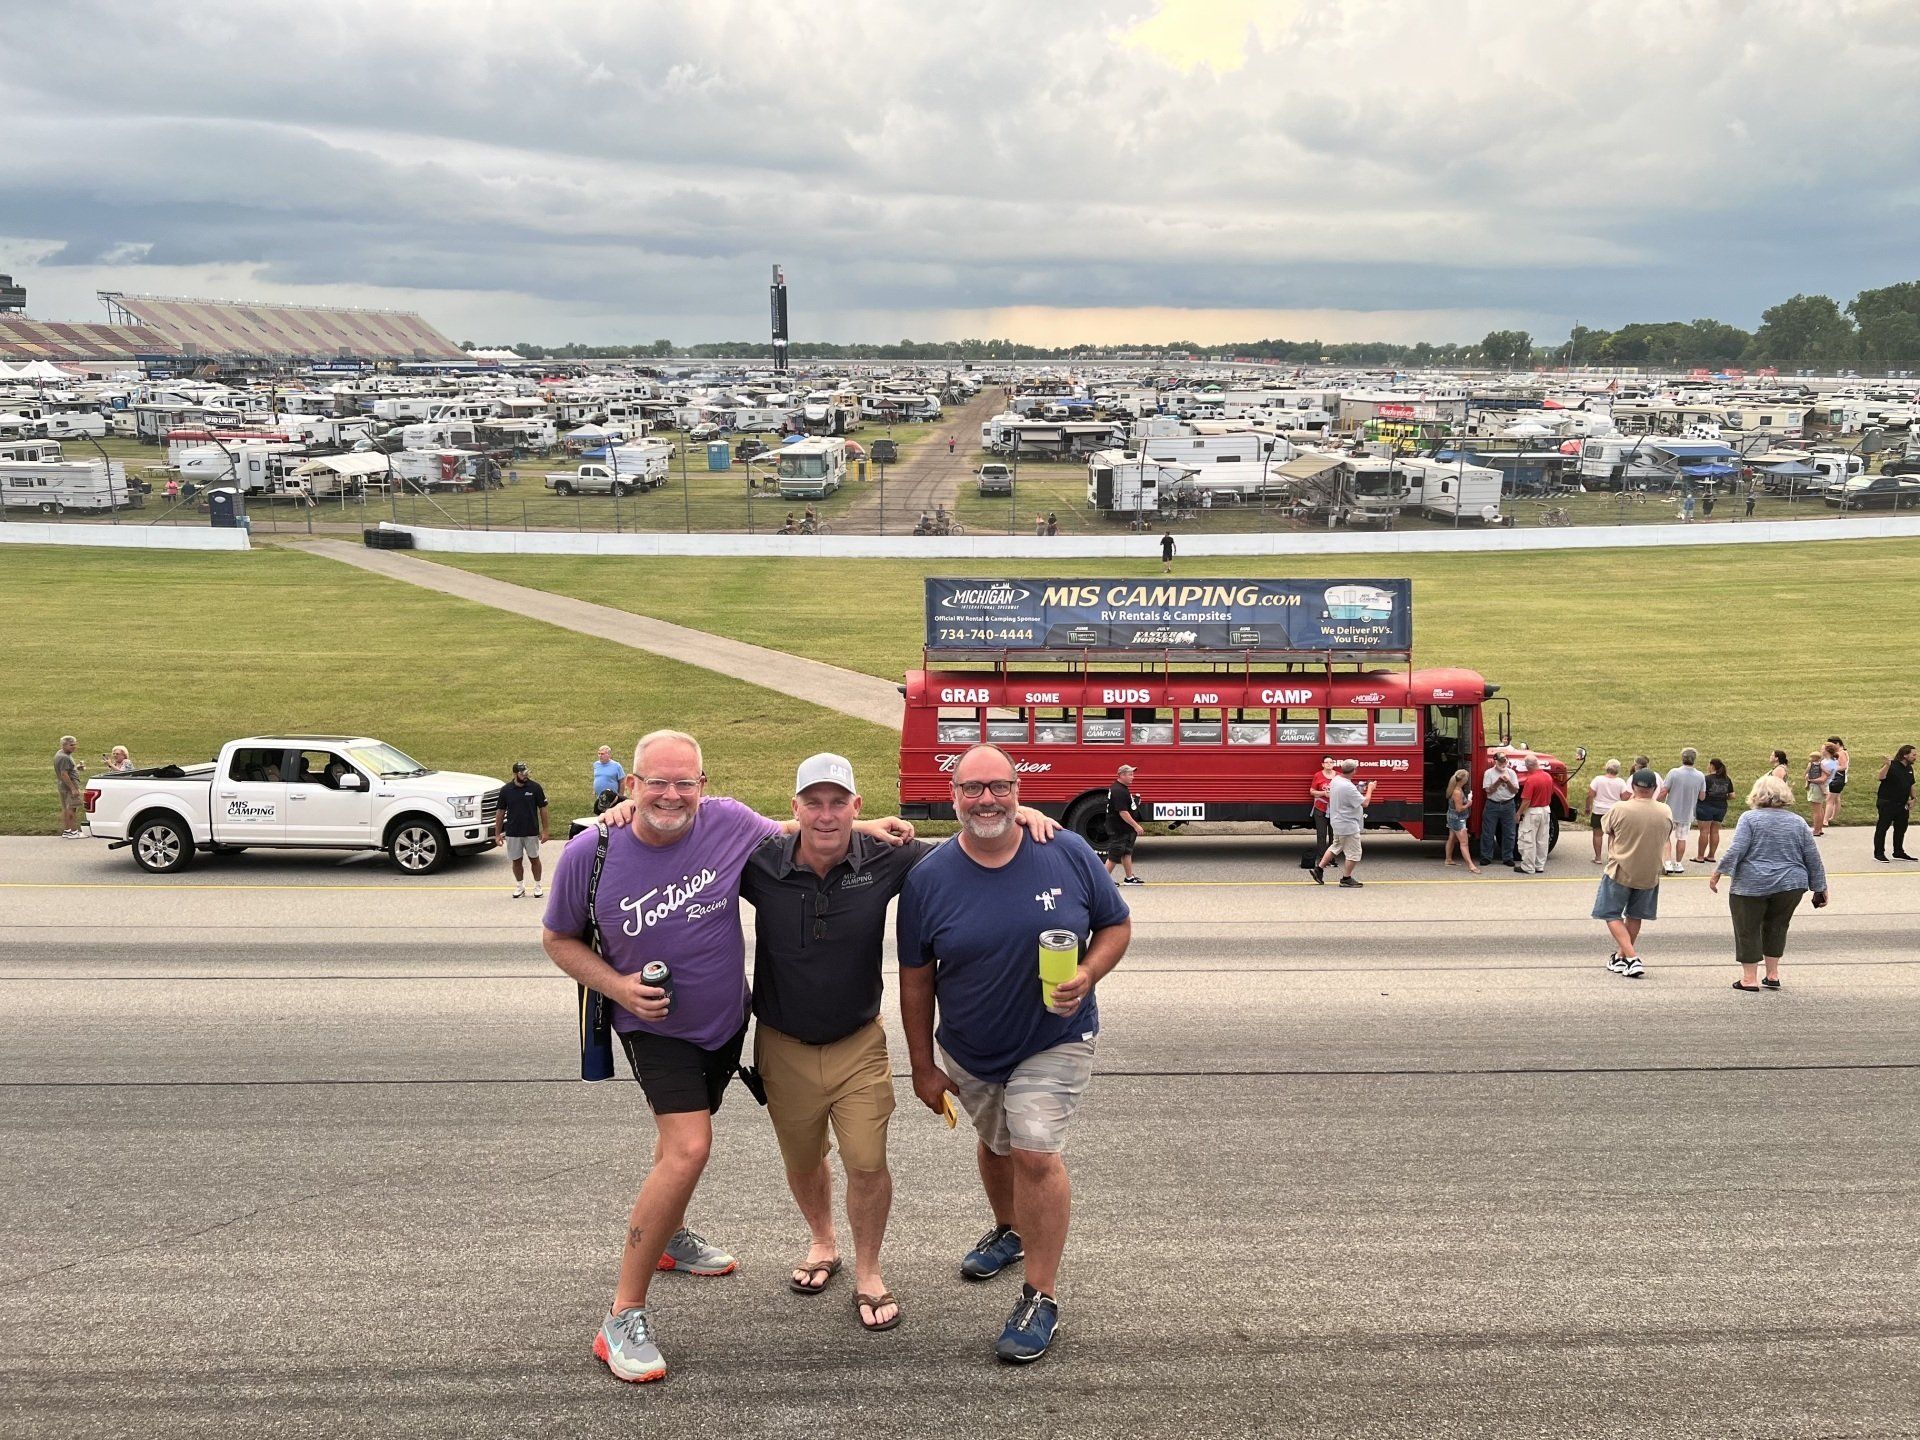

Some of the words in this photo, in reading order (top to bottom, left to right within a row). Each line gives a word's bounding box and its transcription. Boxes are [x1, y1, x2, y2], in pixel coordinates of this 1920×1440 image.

[953, 589, 1015, 605] MICHIGAN
[1040, 586, 1101, 607] MIS
[1101, 611, 1117, 621] RV
[1119, 611, 1160, 621] Rentals
[1162, 611, 1172, 621] &
[1173, 611, 1232, 623] Campsites
[939, 629, 1033, 640] 734-740-4444
[1320, 626, 1335, 635] We
[1336, 626, 1371, 635] Deliver
[1333, 635, 1352, 643] You
[1353, 635, 1380, 645] Enjoy.
[940, 688, 990, 703] GRAB
[1025, 692, 1060, 703] SOME
[1103, 689, 1150, 703] BUDS
[1193, 693, 1219, 704] AND
[1261, 689, 1313, 704] CAMP
[1280, 734, 1316, 742] CAMPING
[935, 754, 1052, 773] Biser
[1379, 759, 1409, 767] BUDS
[829, 764, 849, 780] CAT
[229, 800, 248, 808] MIS
[227, 807, 275, 815] CAMPING
[1155, 806, 1190, 817] Mobil
[1192, 806, 1203, 817] 1
[841, 873, 873, 886] CAMPING
[619, 867, 717, 937] Tootsies
[685, 897, 728, 922] Racing
